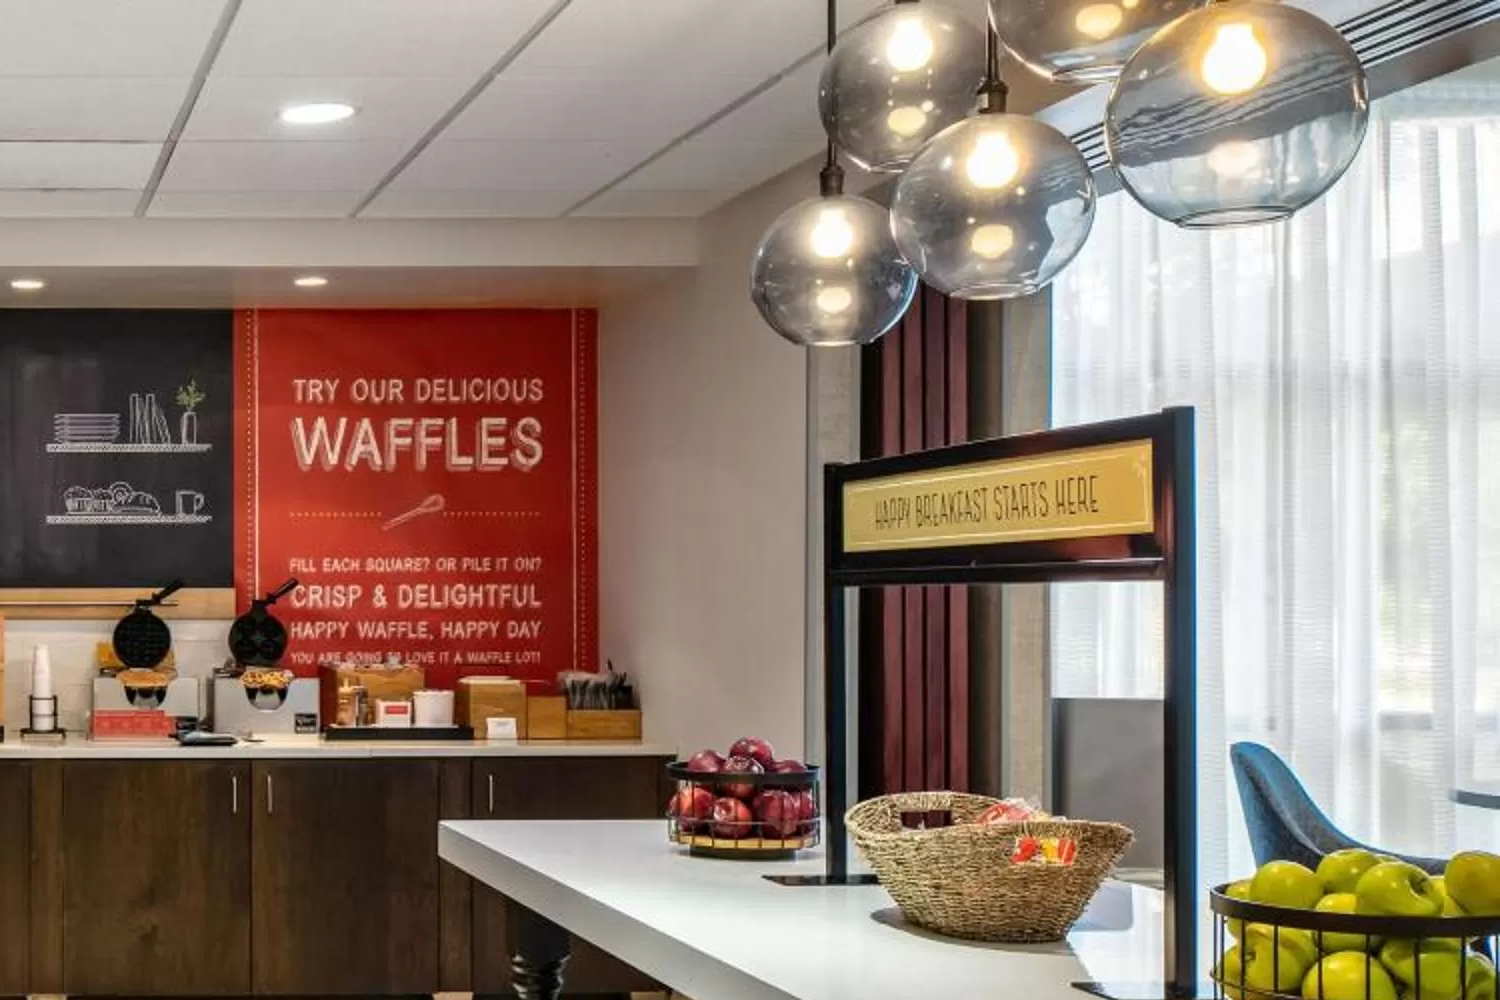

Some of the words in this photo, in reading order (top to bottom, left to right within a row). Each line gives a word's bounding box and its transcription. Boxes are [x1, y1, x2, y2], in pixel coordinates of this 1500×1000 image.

[292, 378, 340, 402] TRY
[351, 378, 404, 402] OUR
[416, 378, 544, 403] DELICIOUS
[292, 416, 544, 472] WAFFLES
[875, 497, 911, 530] HAPPY
[915, 487, 989, 528] BREAKFAST
[992, 481, 1049, 521] STARTS
[1055, 475, 1100, 515] HERE
[289, 557, 317, 573] FILL
[323, 557, 360, 572] EACH
[366, 557, 430, 573] SQUARE?
[436, 557, 457, 572] OR
[462, 557, 491, 572] PILE
[495, 557, 509, 572] IT
[514, 557, 542, 572] ON?
[291, 584, 363, 608] CRISP
[372, 584, 389, 608] &
[397, 584, 543, 608] DELIGHTFUL
[290, 621, 349, 639] HAPPY
[358, 621, 434, 641] WAFFLE,
[441, 621, 500, 639] HAPPY
[507, 621, 542, 639] DAY
[291, 652, 314, 665] YOU
[405, 652, 436, 665] LOVE
[439, 652, 449, 664] IT
[454, 652, 463, 664] A
[467, 652, 512, 664] WAFFLE
